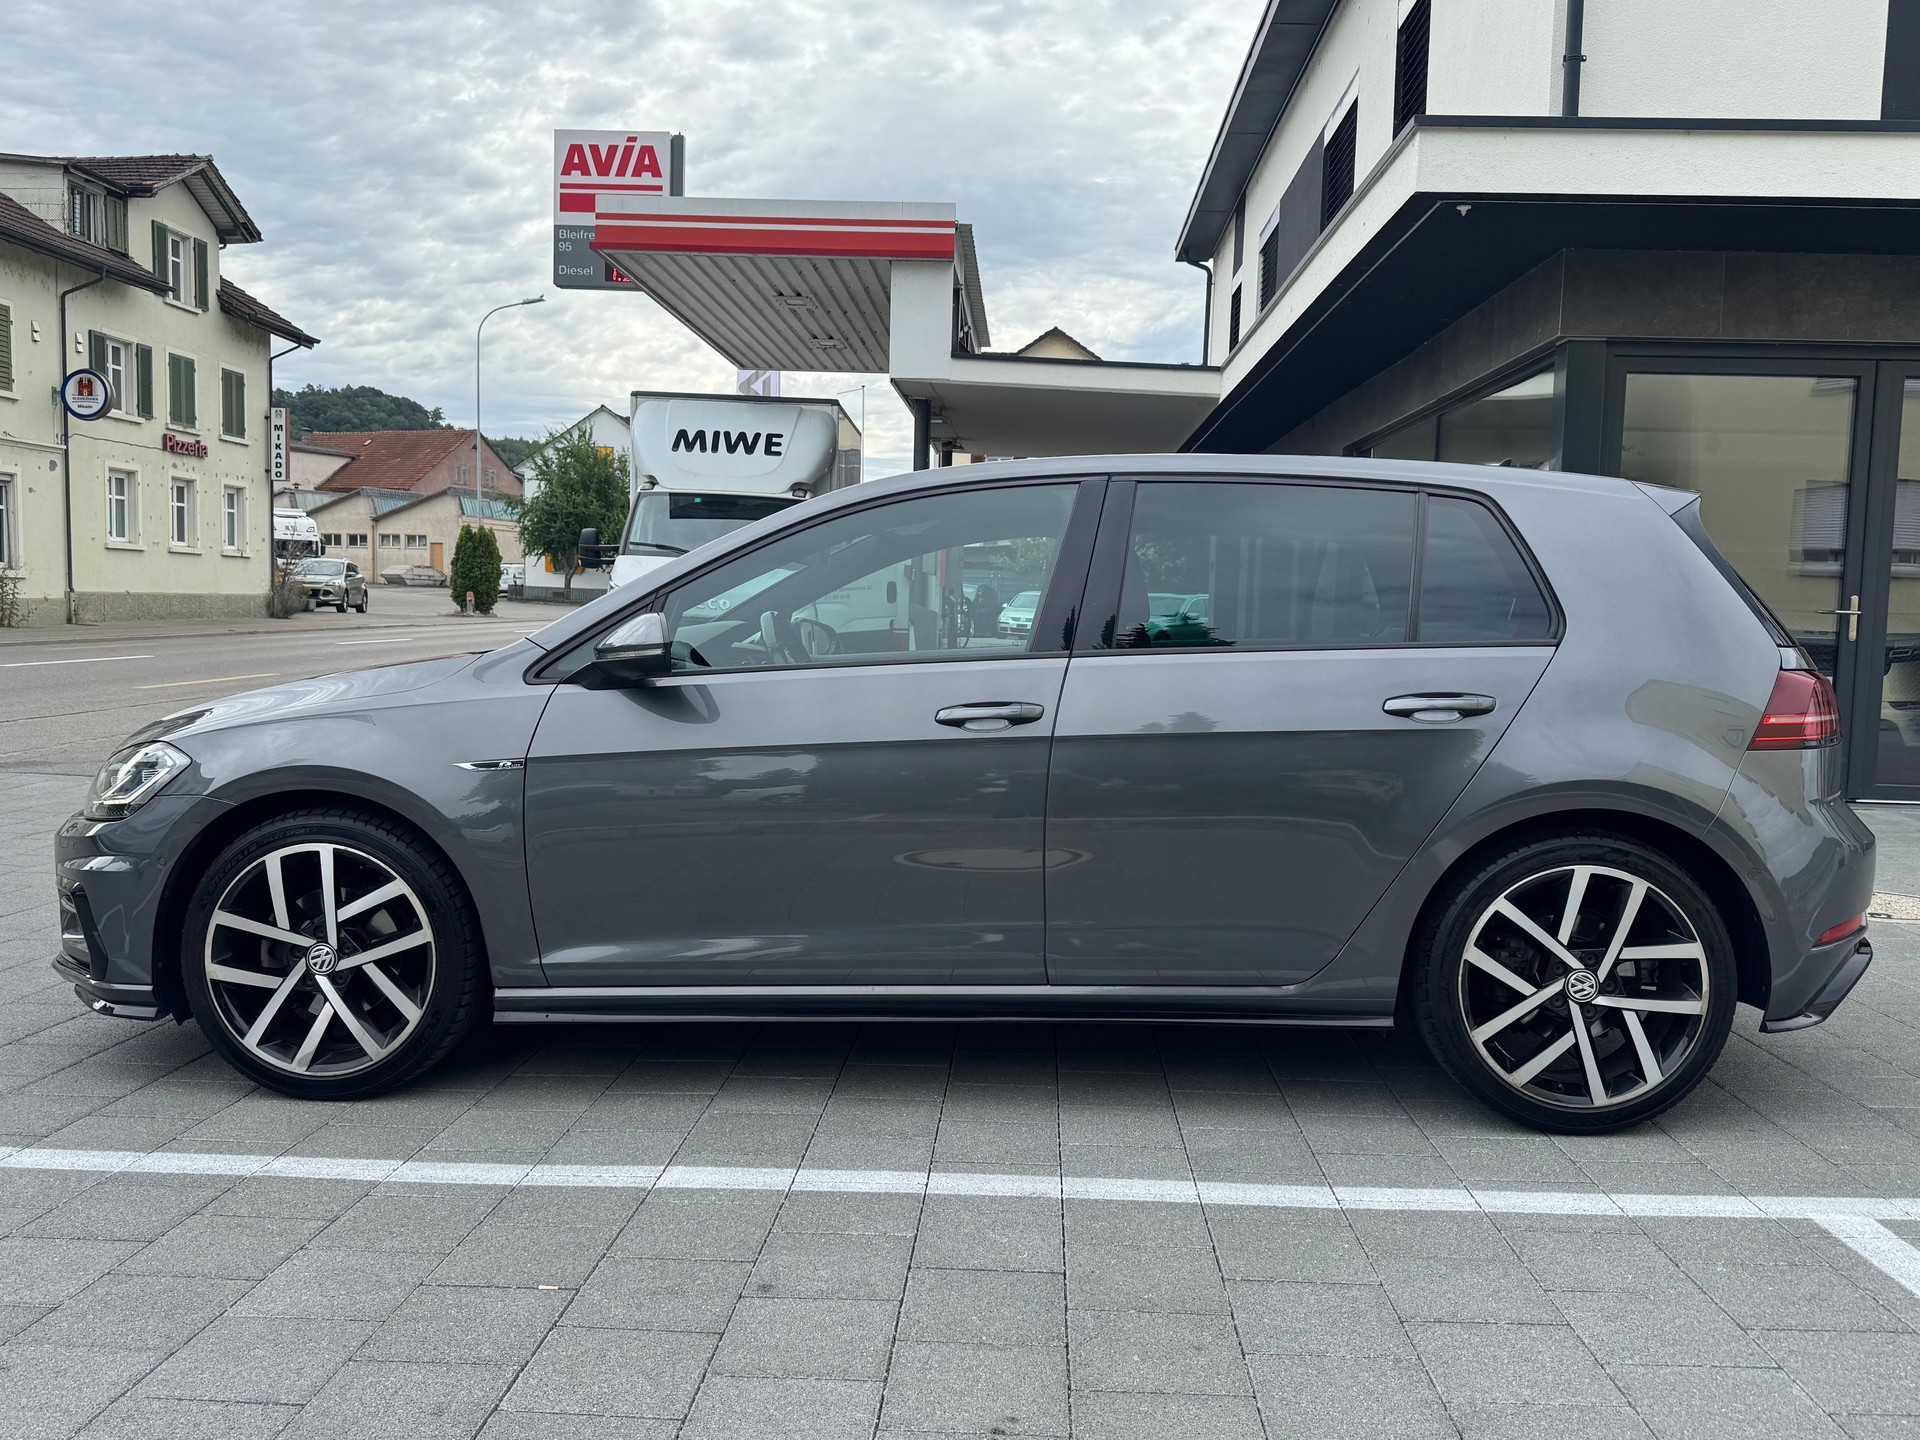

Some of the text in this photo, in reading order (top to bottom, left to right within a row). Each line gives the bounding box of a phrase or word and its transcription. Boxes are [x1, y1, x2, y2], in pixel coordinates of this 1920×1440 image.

[559, 230, 595, 240] Bleifre
[559, 242, 572, 251] 95
[558, 265, 593, 275] Diesel
[166, 433, 209, 458] Pizzeria
[671, 428, 784, 457] MIWE
[273, 424, 284, 478] MIKADO
[286, 828, 310, 837] SPORT
